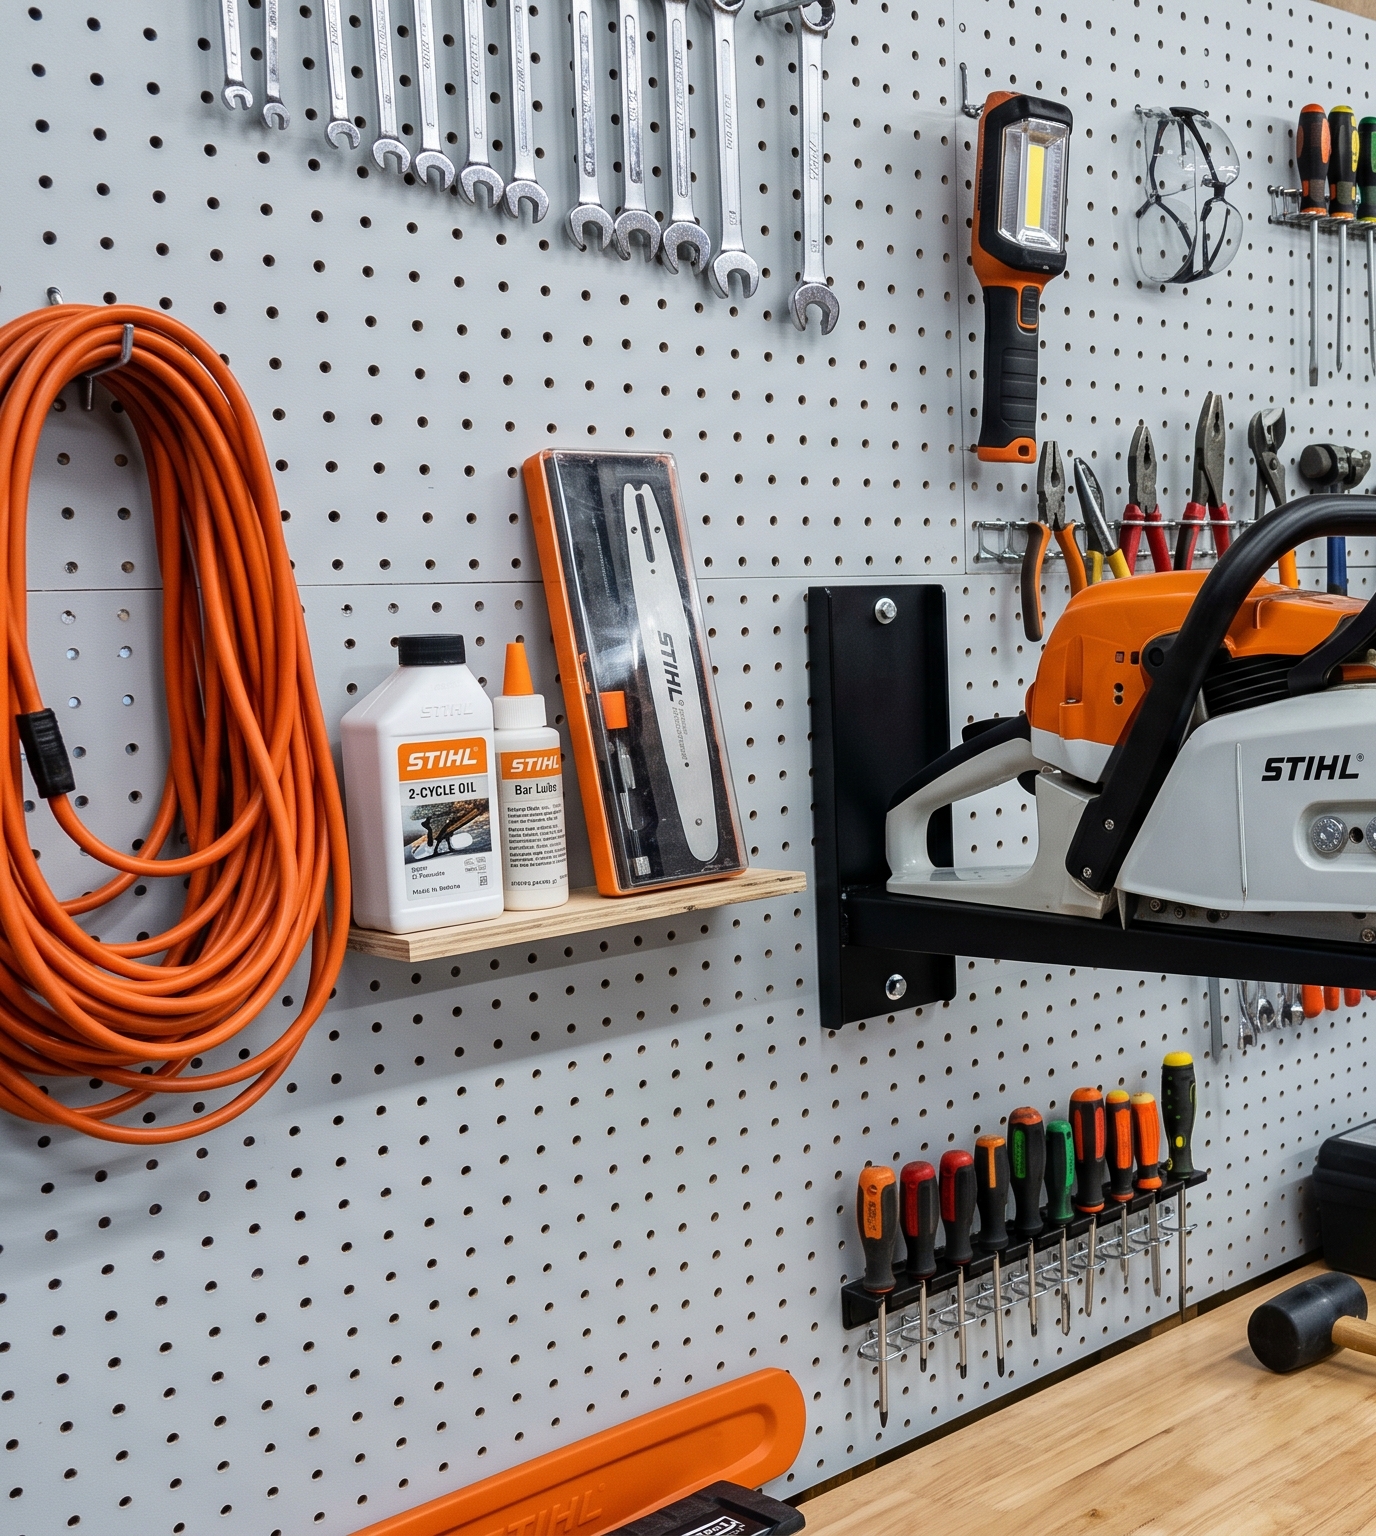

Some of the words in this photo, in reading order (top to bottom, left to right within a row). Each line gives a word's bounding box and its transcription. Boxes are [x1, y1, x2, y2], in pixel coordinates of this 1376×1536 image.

[657, 630, 683, 703] STIHL
[406, 748, 478, 771] STIHL
[510, 755, 560, 773] STIHL
[1261, 755, 1360, 782] STIHL
[408, 783, 456, 800] 2-CYCLE
[458, 781, 477, 795] OIL
[514, 784, 533, 796] Bar
[484, 1489, 603, 1536] TIHL
